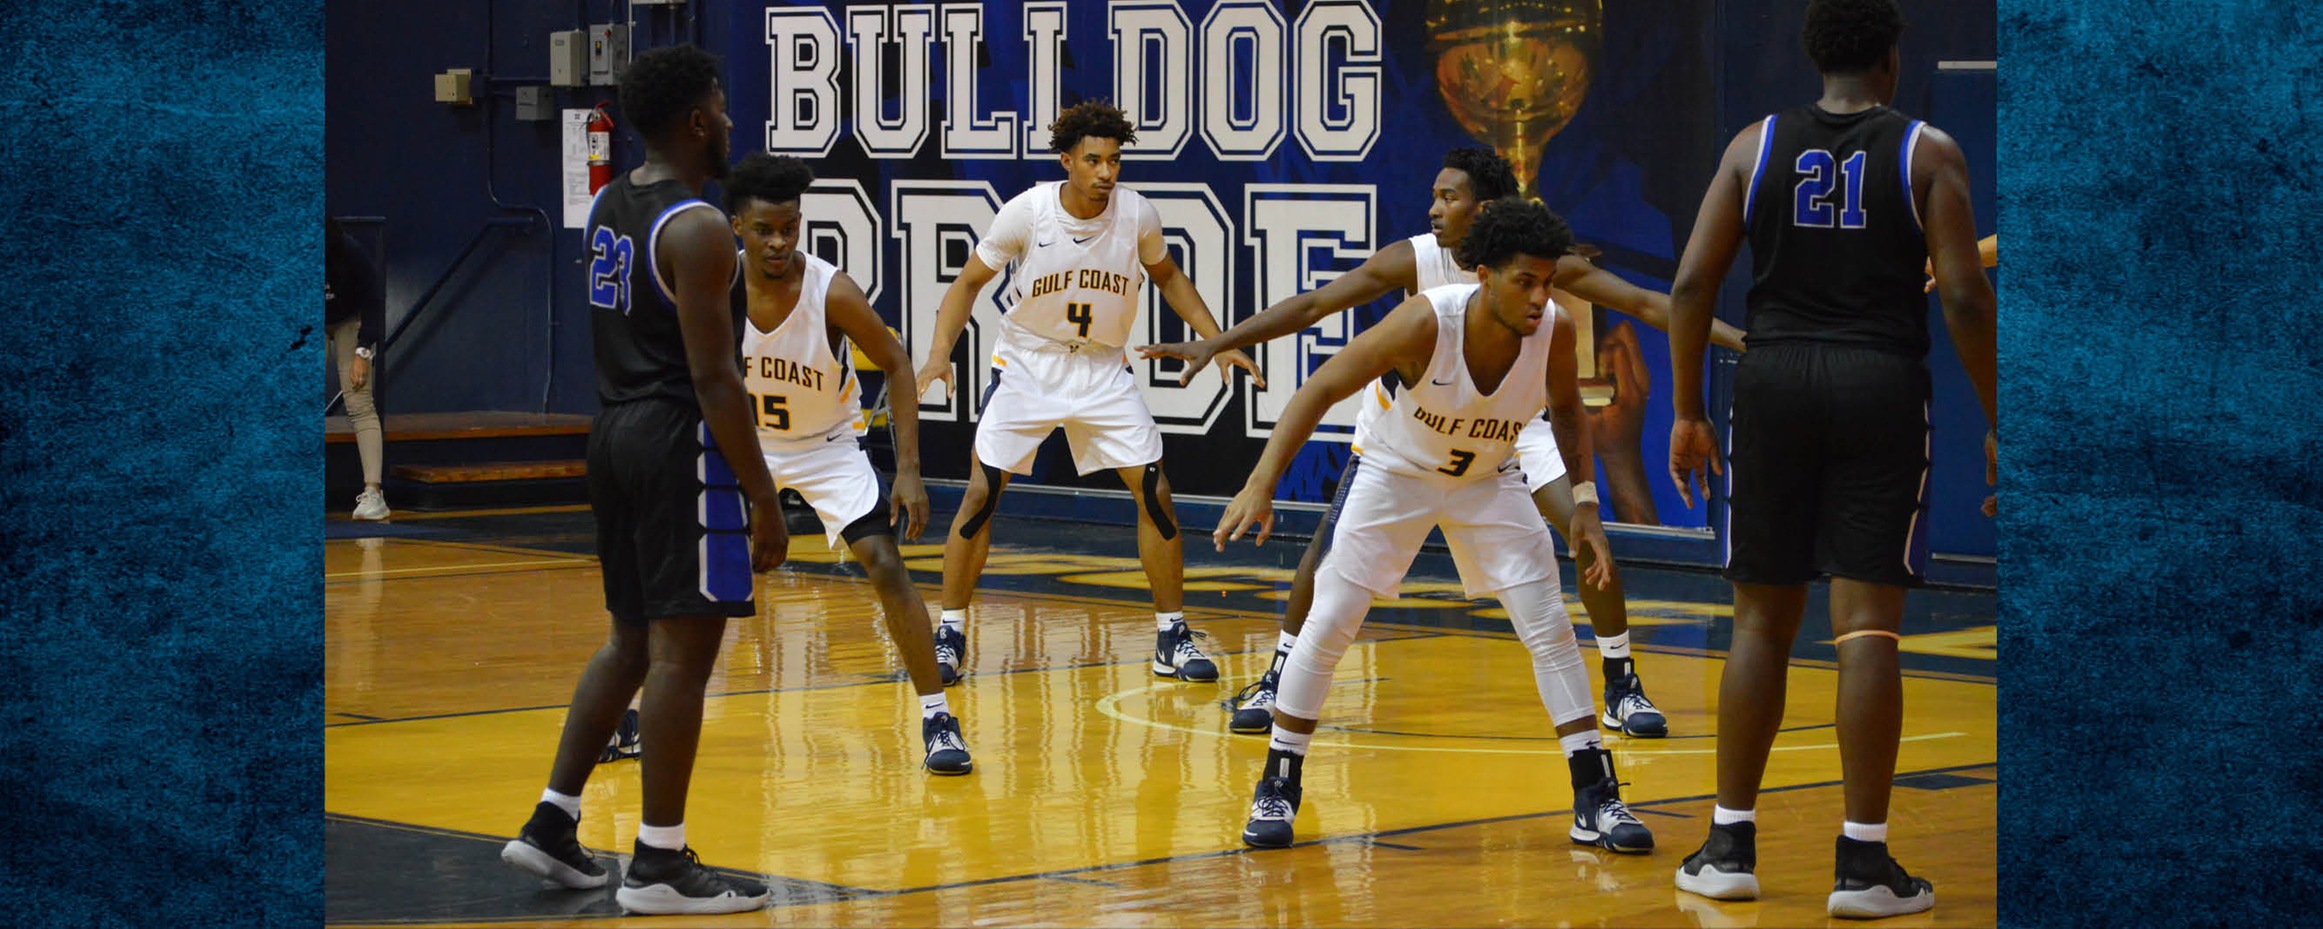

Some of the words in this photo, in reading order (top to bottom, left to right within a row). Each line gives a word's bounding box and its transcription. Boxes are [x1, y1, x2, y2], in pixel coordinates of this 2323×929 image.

[764, 0, 1382, 161] BULLDOG
[1795, 149, 1866, 229] 21
[590, 225, 634, 315] 23
[1032, 270, 1073, 297] GULF
[1080, 269, 1129, 296] COAST
[798, 178, 1377, 441] PRDE
[1067, 302, 1092, 337] 4
[761, 357, 823, 391] COAST
[1468, 419, 1526, 442] COAS
[1437, 449, 1476, 477] 3
